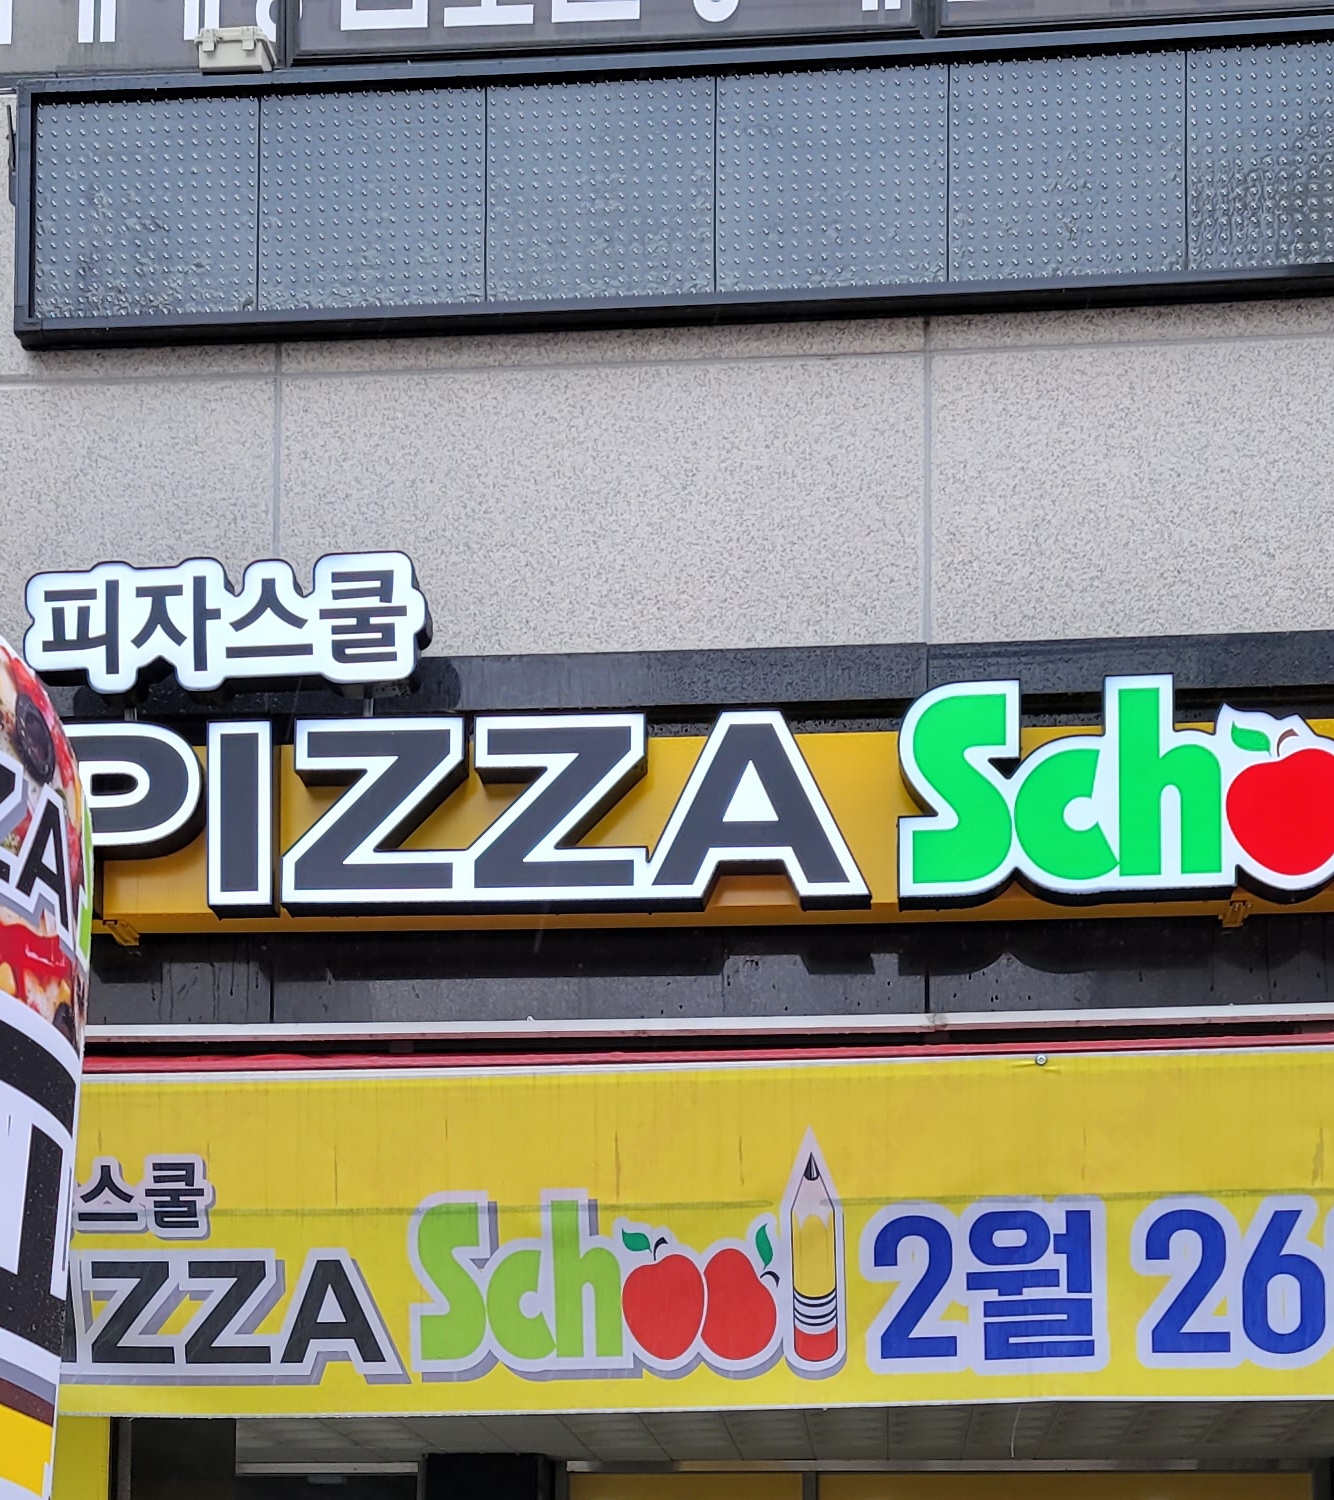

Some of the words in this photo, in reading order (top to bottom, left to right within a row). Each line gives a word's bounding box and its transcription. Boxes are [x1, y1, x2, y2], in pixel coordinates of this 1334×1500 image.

[41, 568, 408, 676] 피자스쿨
[67, 710, 870, 907] PIZZA
[62, 1258, 387, 1365] ZZA
[417, 1148, 839, 1363] School
[77, 1161, 207, 1230] 스쿨
[870, 1208, 1097, 1363] 2월
